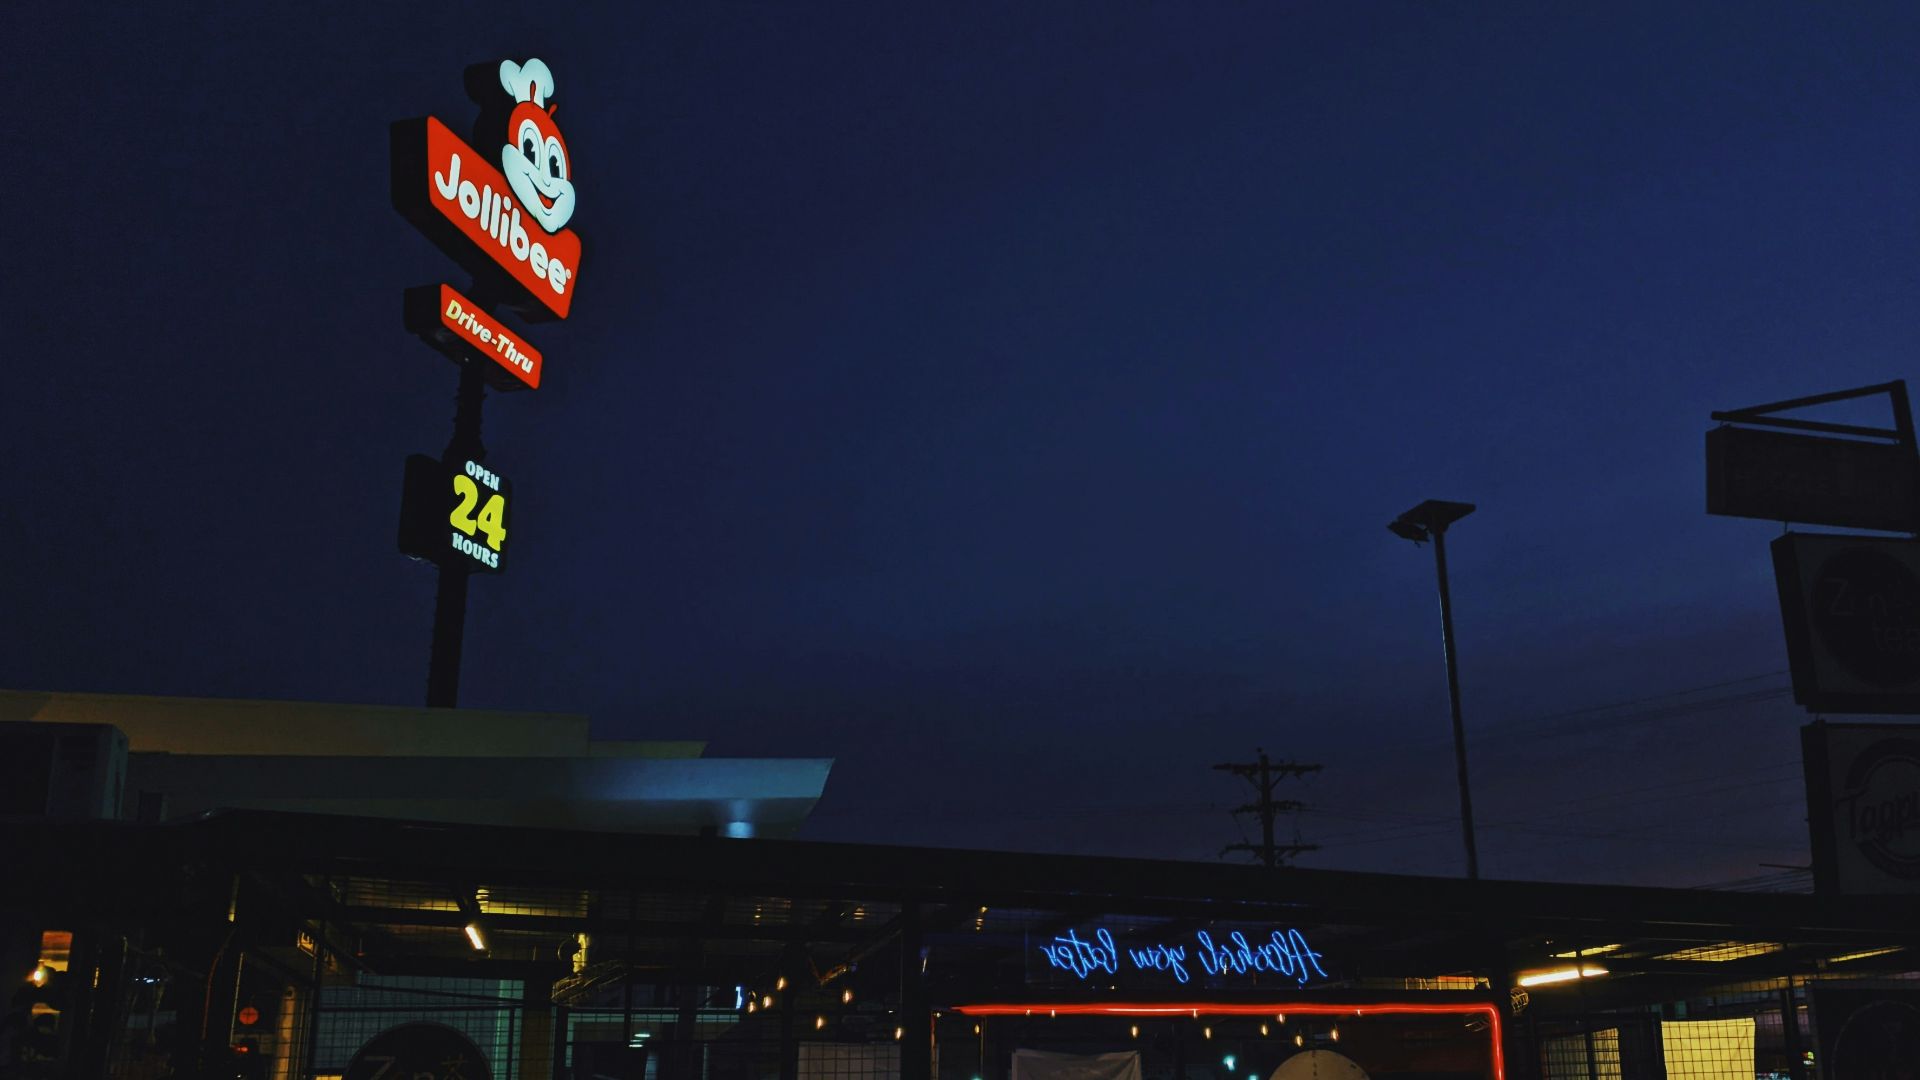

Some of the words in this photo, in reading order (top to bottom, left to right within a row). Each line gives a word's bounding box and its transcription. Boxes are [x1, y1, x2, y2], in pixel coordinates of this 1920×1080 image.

[435, 153, 567, 295] Jollibee
[445, 299, 534, 374] Drive-Thru
[449, 474, 506, 552] 24
[465, 460, 500, 491] OPEN
[452, 532, 499, 568] HOURS
